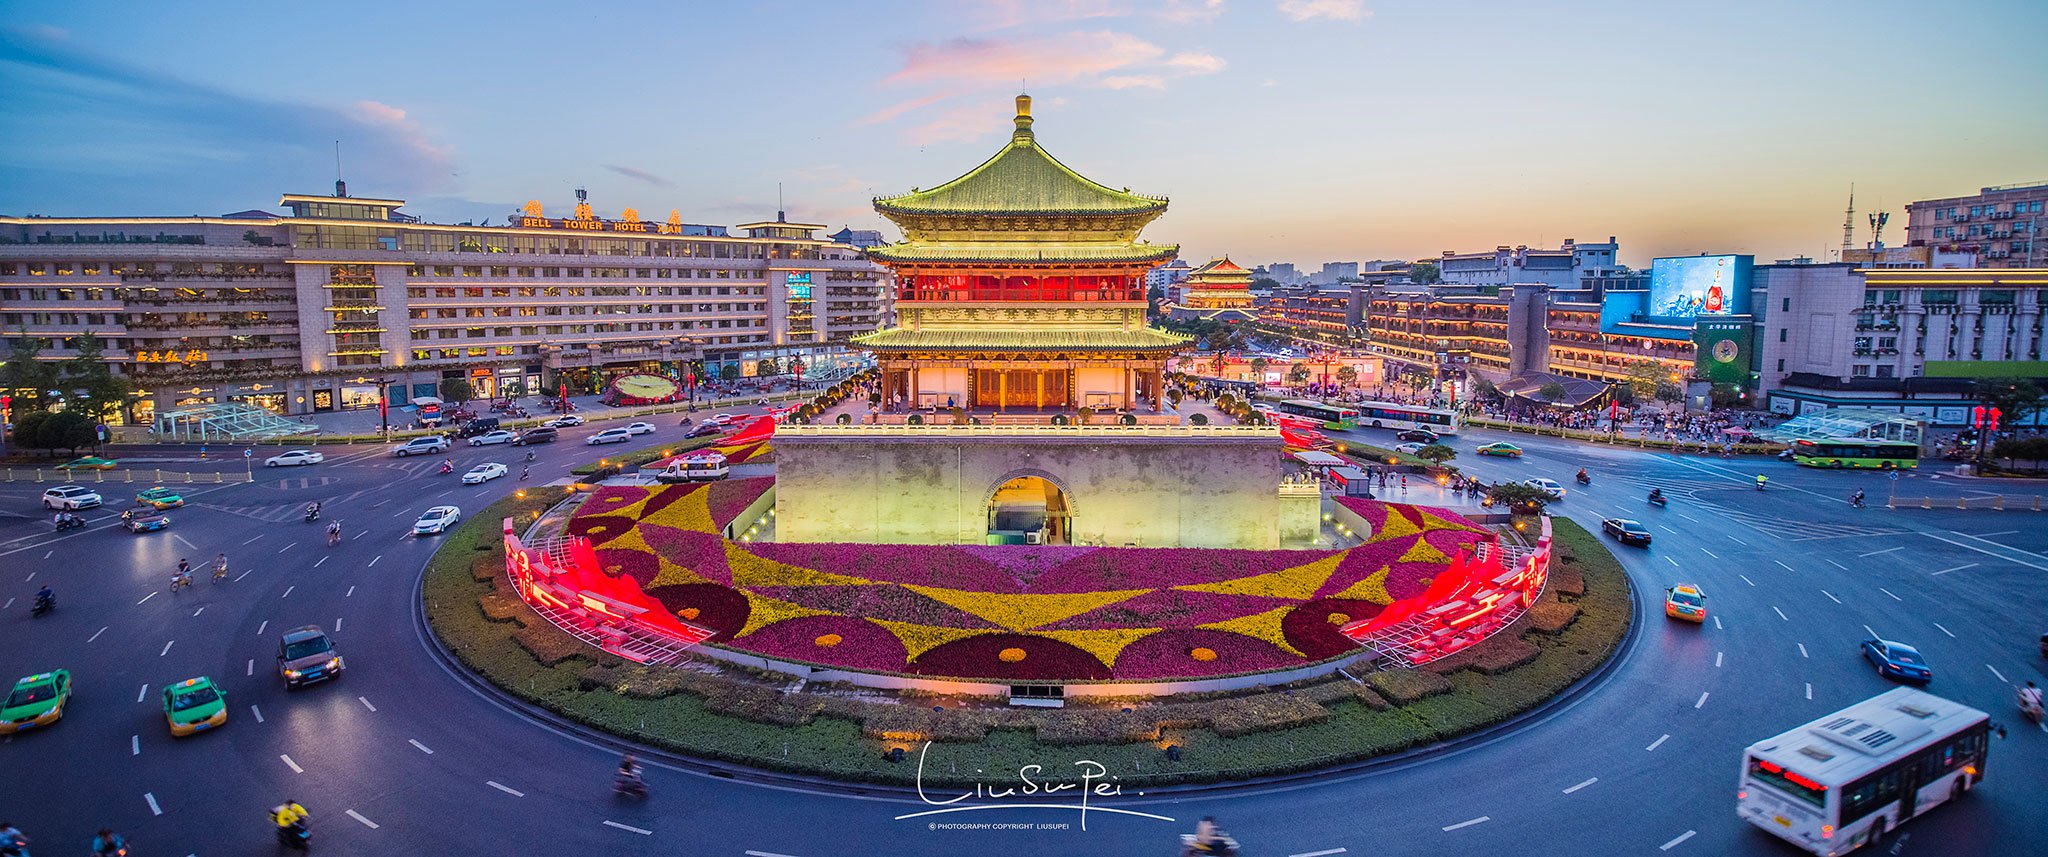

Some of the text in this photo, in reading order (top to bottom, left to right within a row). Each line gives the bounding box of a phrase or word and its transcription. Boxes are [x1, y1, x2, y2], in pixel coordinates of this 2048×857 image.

[523, 218, 552, 228] BELL
[563, 220, 603, 230] TOWER
[614, 222, 647, 232] HOTEL
